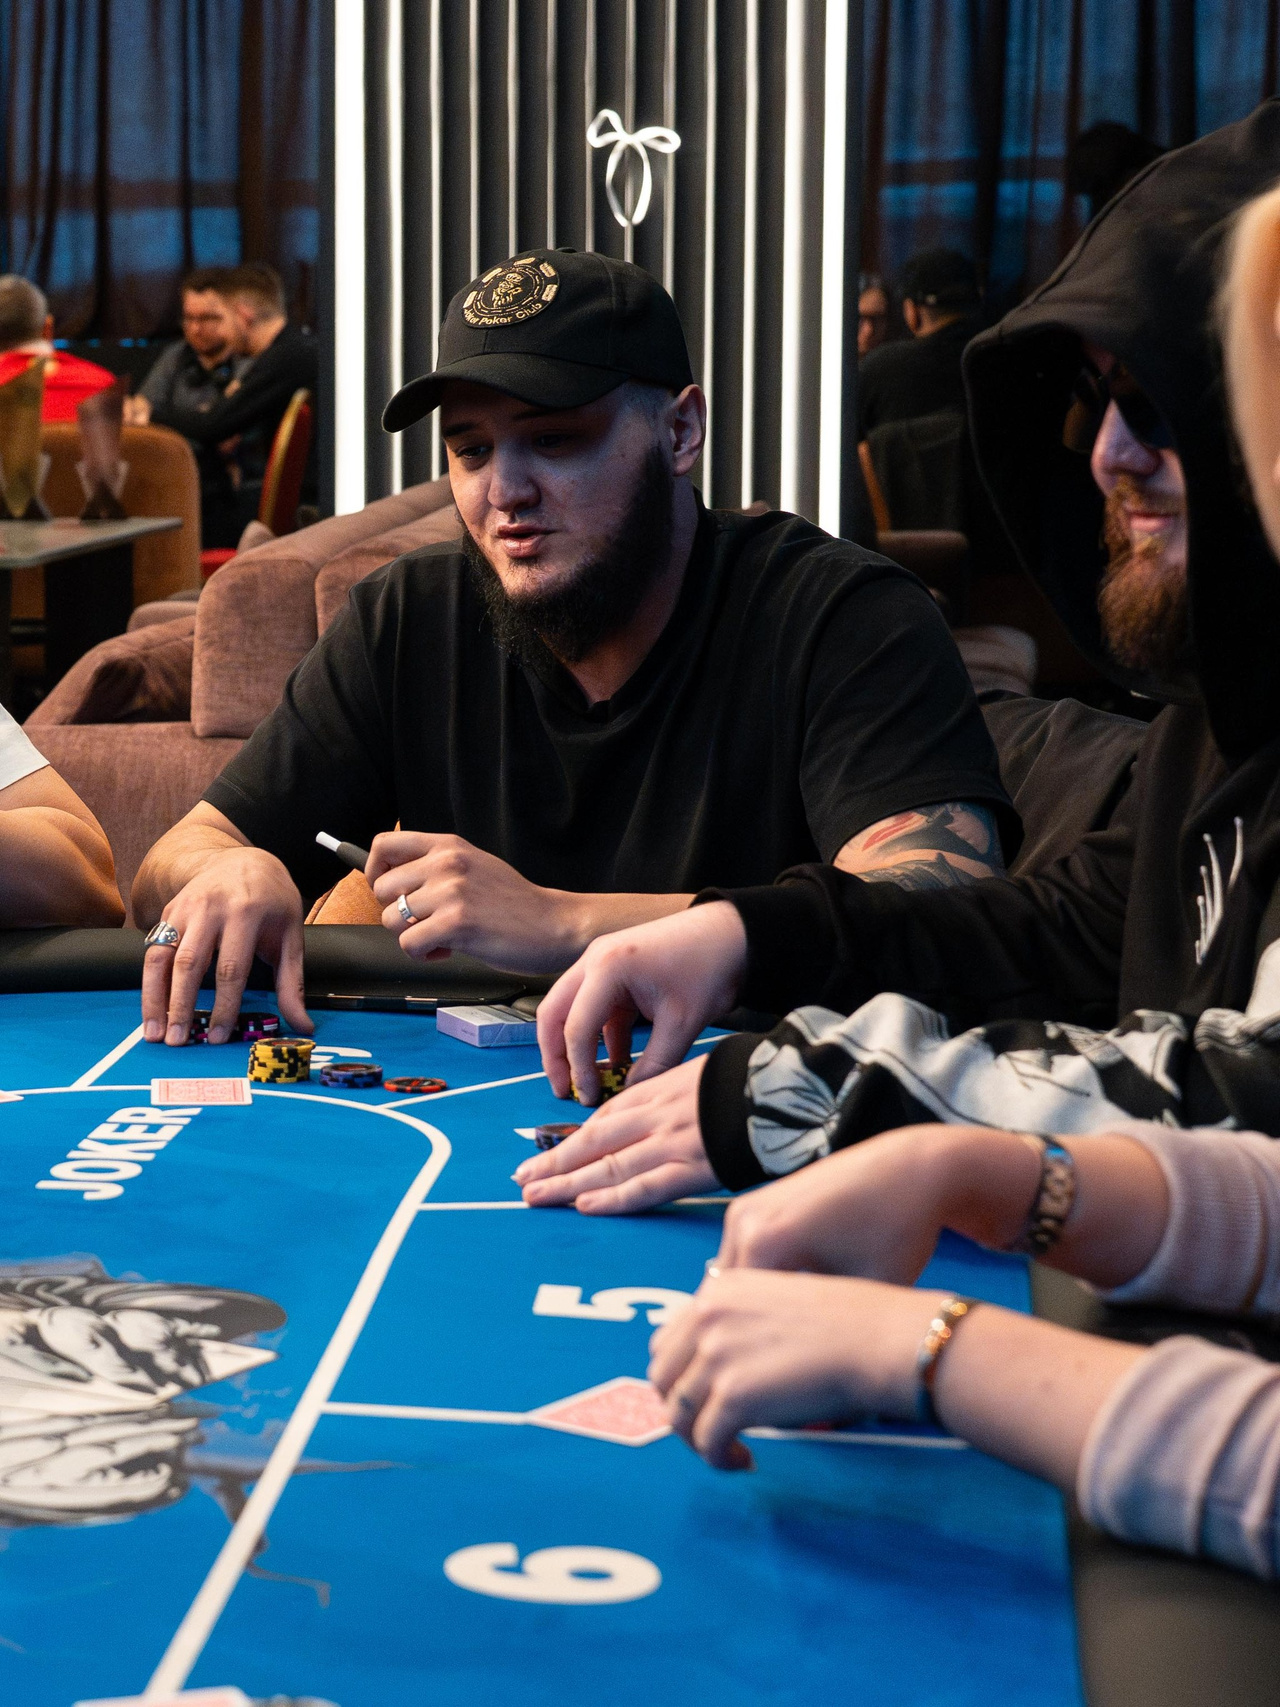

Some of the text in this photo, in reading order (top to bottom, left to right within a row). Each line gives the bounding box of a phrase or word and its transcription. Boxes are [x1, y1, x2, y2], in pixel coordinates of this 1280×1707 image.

[478, 316, 513, 325] Poker
[515, 303, 543, 319] Club
[35, 1107, 203, 1201] JOKER
[532, 1283, 696, 1327] 5
[443, 1541, 663, 1606] 6
